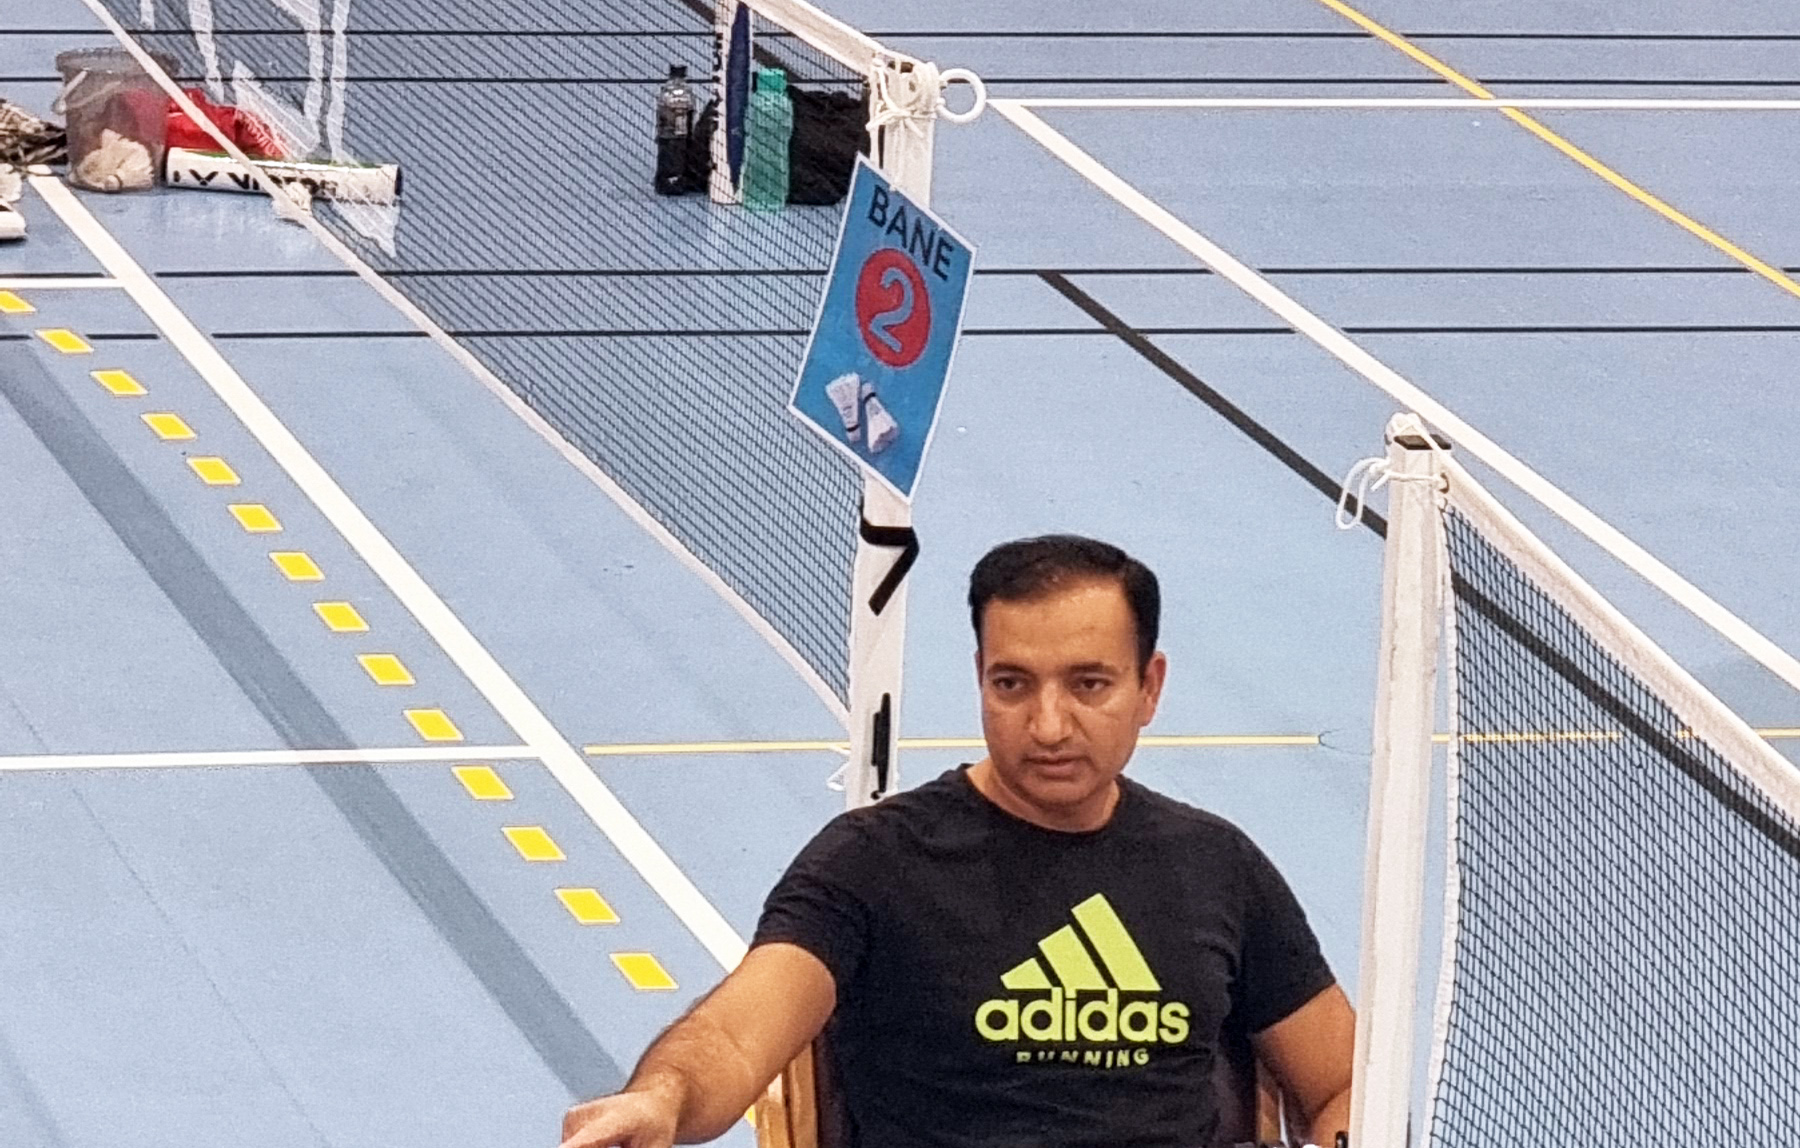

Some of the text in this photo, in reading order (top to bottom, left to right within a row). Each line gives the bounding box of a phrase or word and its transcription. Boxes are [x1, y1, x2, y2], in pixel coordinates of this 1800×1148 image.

[228, 171, 339, 197] VIOR
[868, 184, 954, 281] BANE
[868, 267, 915, 353] 2
[975, 986, 1190, 1044] adidas
